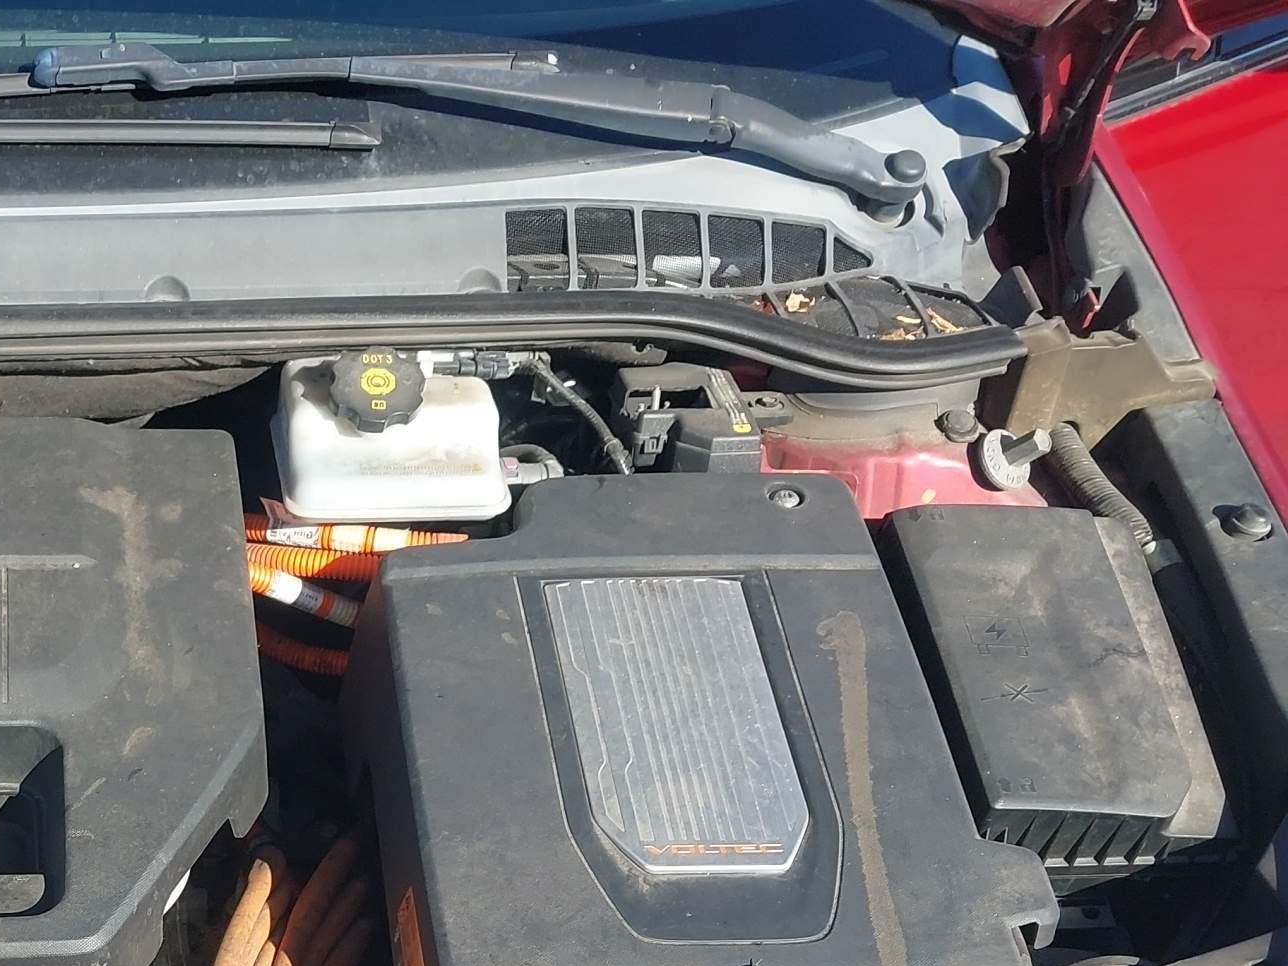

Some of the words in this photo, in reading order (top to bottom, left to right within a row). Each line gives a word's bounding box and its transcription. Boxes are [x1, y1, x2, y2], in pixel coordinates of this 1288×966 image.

[362, 354, 383, 364] DOT
[385, 354, 393, 364] 3
[643, 843, 785, 856] VOLTEC
